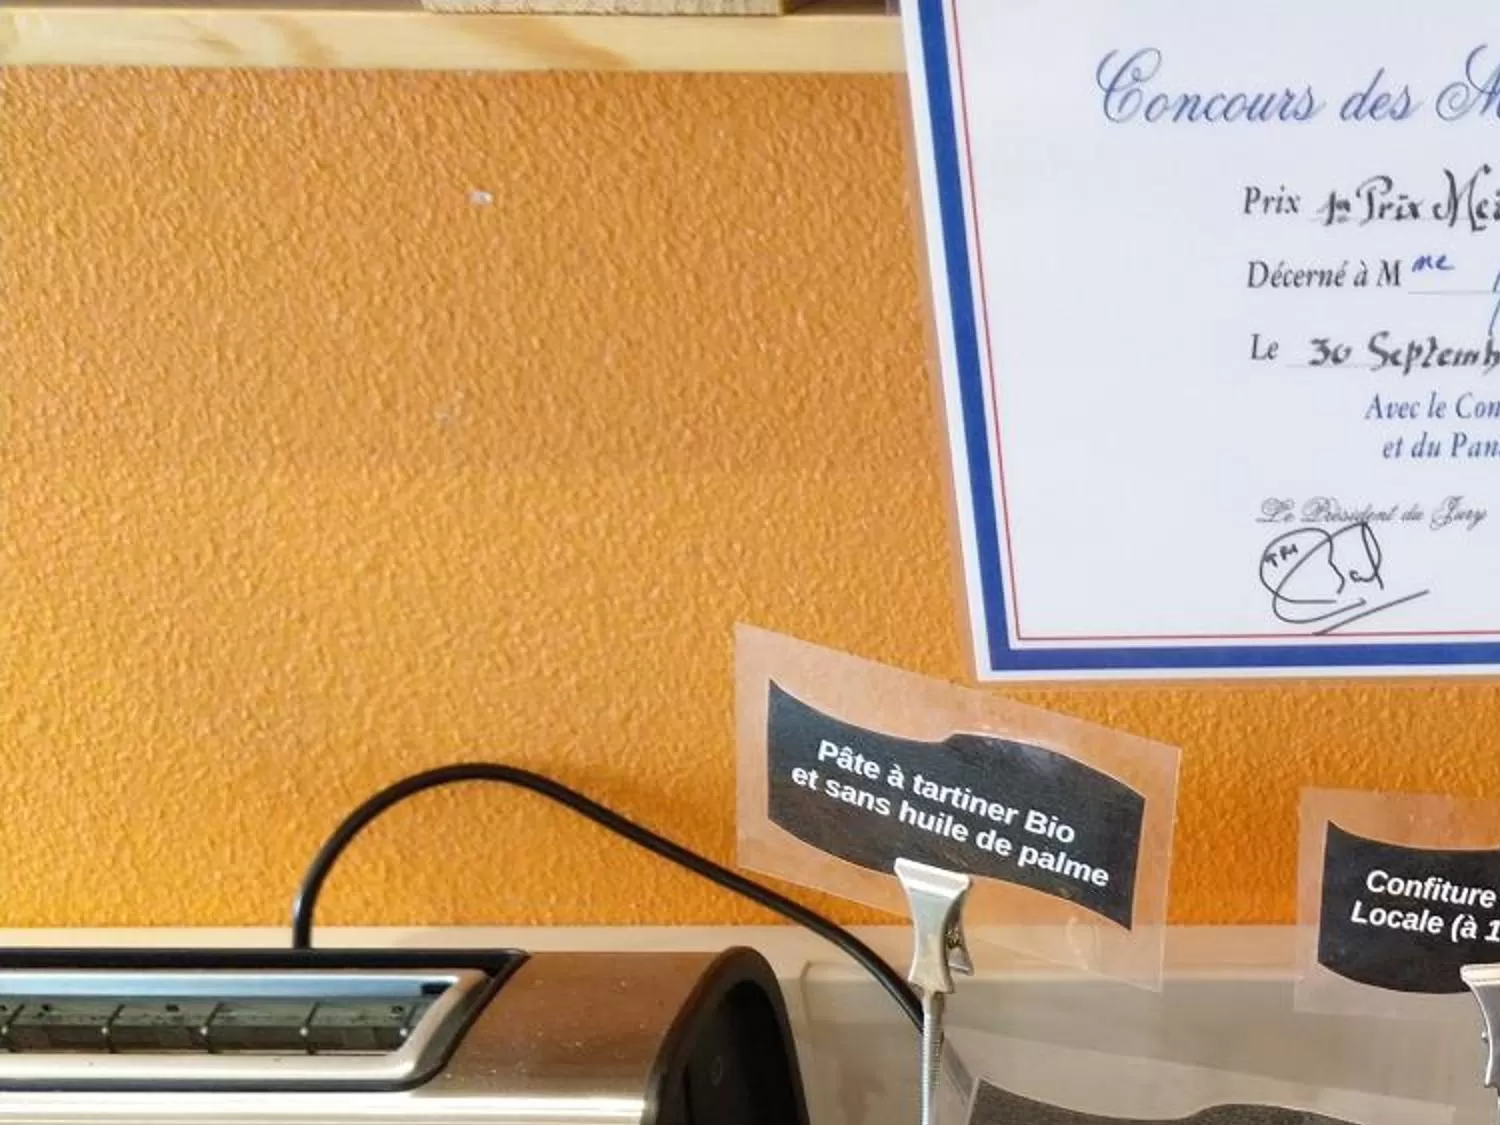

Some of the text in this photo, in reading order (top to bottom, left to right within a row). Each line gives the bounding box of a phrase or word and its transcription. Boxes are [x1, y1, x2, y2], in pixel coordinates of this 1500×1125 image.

[1096, 48, 1326, 124] Concours
[1339, 68, 1424, 122] des
[1243, 186, 1301, 217] Prix
[1247, 258, 1346, 290] Décerné
[1353, 259, 1369, 289] à
[1250, 333, 1280, 363] Le
[1308, 337, 1352, 367] 30
[1365, 392, 1421, 419] Avec
[1430, 391, 1449, 419] le
[1383, 434, 1403, 459] et
[1412, 430, 1442, 458] du
[816, 738, 1077, 845] Pâte à tartiner Bio
[790, 766, 1112, 888] et sans huile de palme
[1365, 868, 1498, 910] Confiture
[1350, 900, 1446, 936] Locale
[1450, 913, 1479, 944] (à
